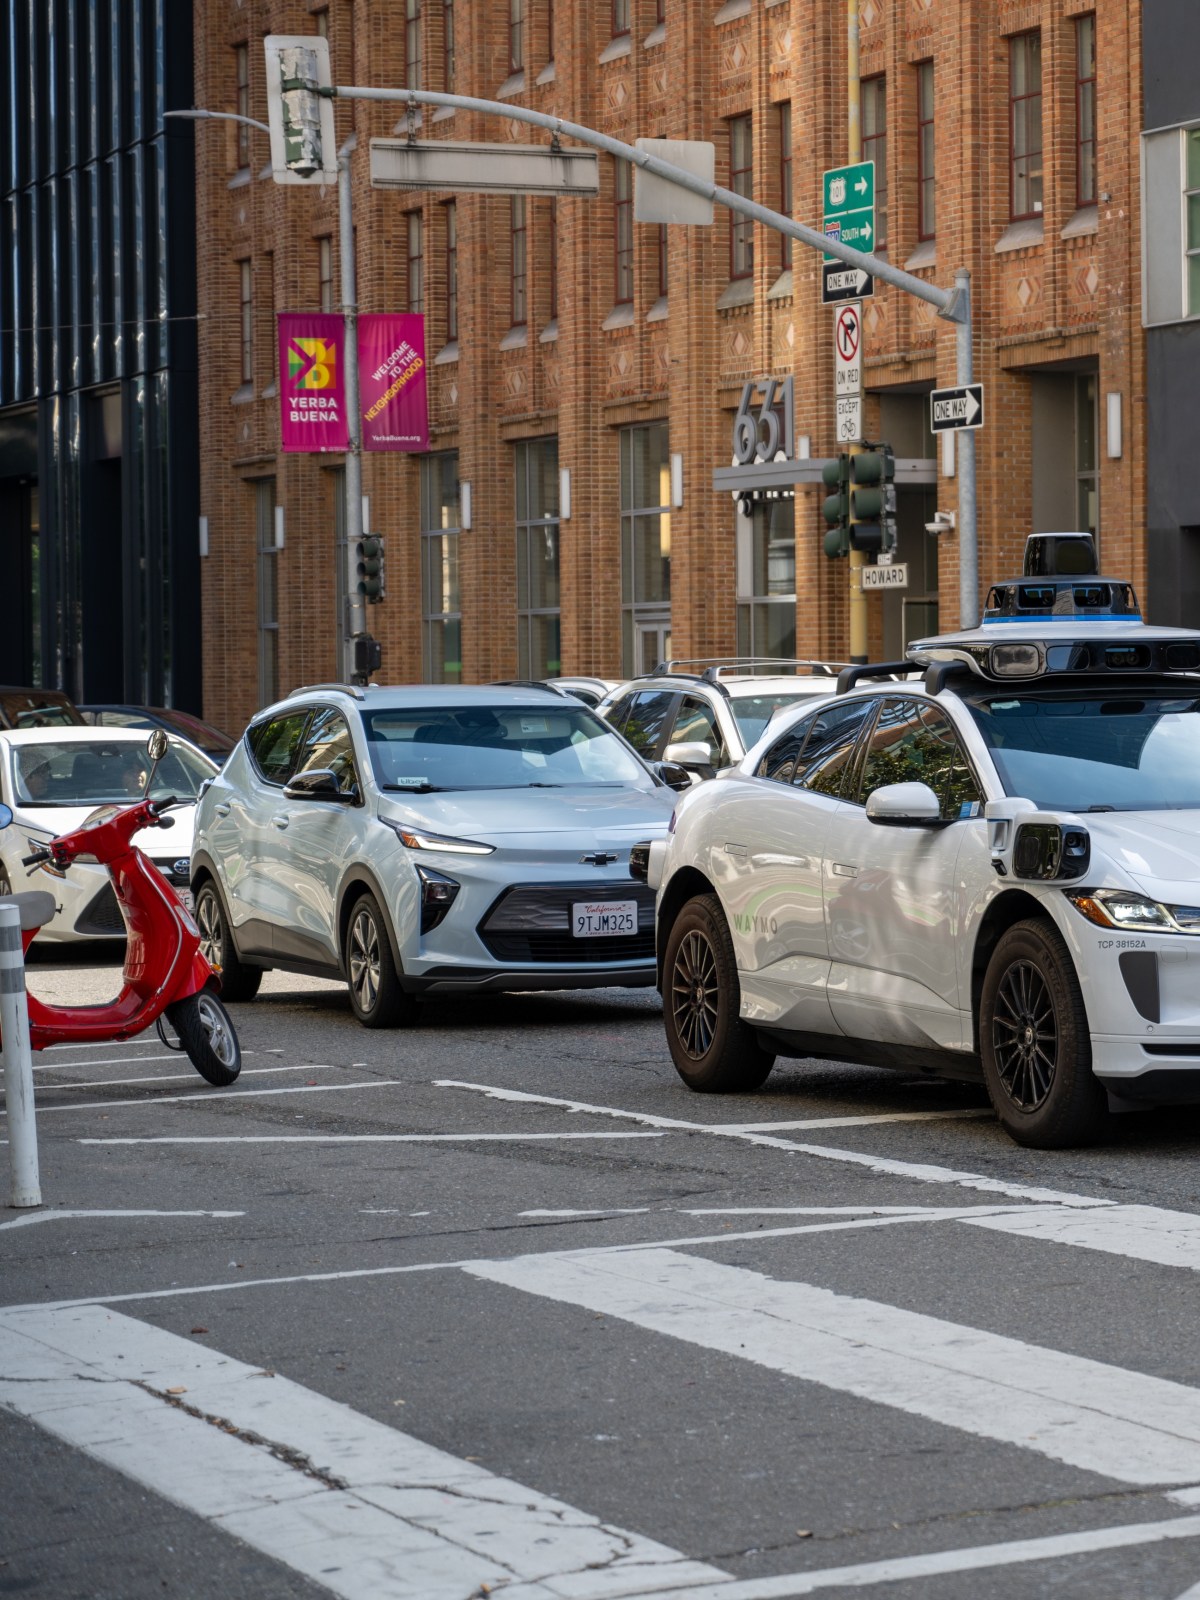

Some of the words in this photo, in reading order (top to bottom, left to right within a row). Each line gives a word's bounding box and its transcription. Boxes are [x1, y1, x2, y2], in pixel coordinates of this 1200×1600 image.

[842, 227, 859, 241] SOUTH
[828, 275, 842, 289] ONE
[845, 271, 858, 286] WAY
[371, 340, 411, 382] WELCOME
[389, 365, 402, 379] TO
[400, 348, 418, 368] THE
[838, 370, 846, 385] ON
[848, 368, 859, 383] RED
[363, 357, 424, 422] NEIGHBORHOOD
[288, 397, 338, 409] YERBA
[838, 401, 859, 415] EXCEPT
[935, 401, 950, 420] ONE
[951, 399, 968, 417] WAY
[289, 411, 339, 422] BUENA
[734, 376, 794, 464] 631
[865, 568, 904, 585] HOWARD
[586, 904, 626, 915] California
[577, 914, 633, 933] 9TJM325
[733, 913, 778, 935] WAYMO
[1097, 940, 1114, 949] TCP
[1115, 940, 1146, 949] 38152A
